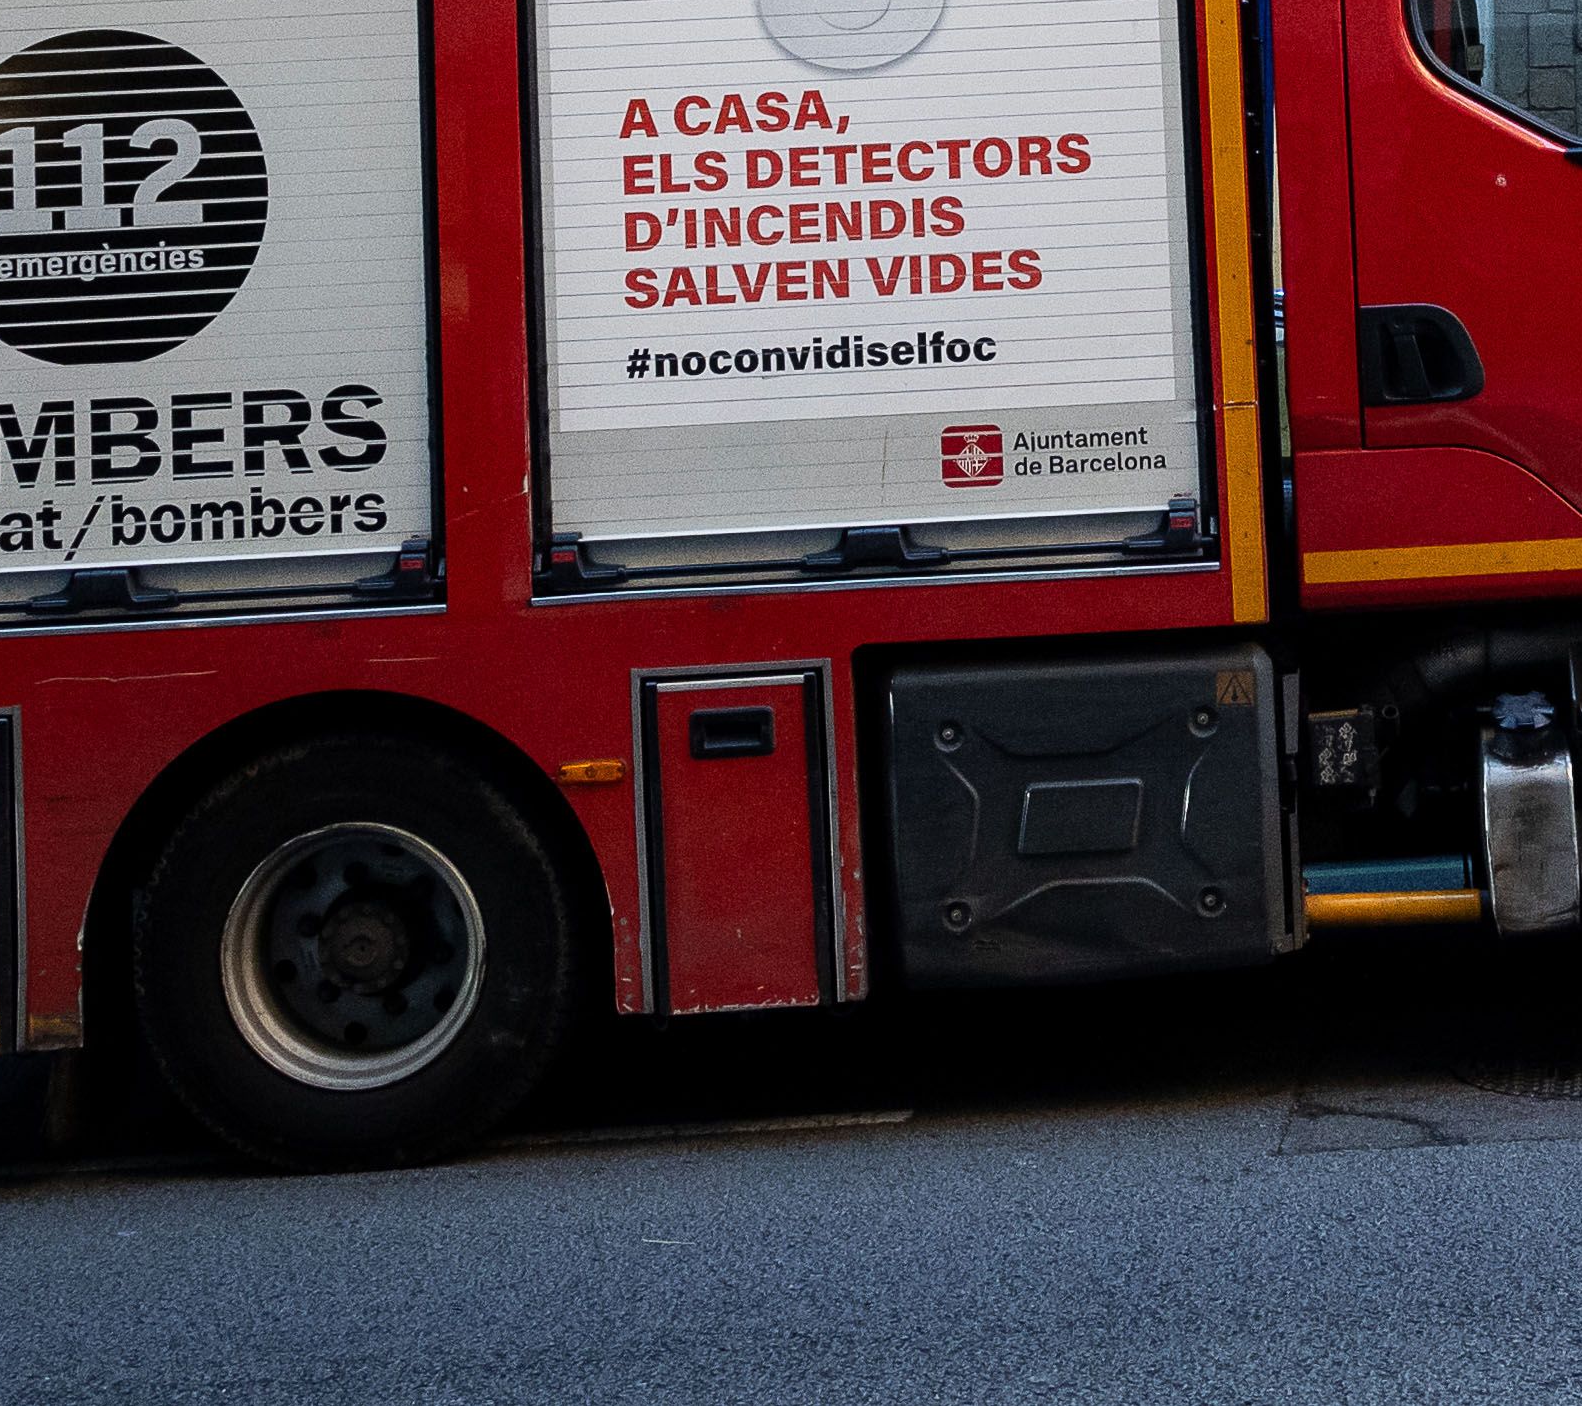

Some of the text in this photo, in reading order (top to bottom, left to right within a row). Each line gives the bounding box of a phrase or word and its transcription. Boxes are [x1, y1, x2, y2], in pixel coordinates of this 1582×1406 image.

[619, 89, 851, 139] A CASA,
[622, 133, 1092, 195] ELS DETECTORS
[623, 249, 1044, 309] SALVEN VIDES
[626, 331, 997, 380] #noconvidiselfoc
[1013, 427, 1148, 453] Ajuntament
[1014, 452, 1167, 476] de Barcelona
